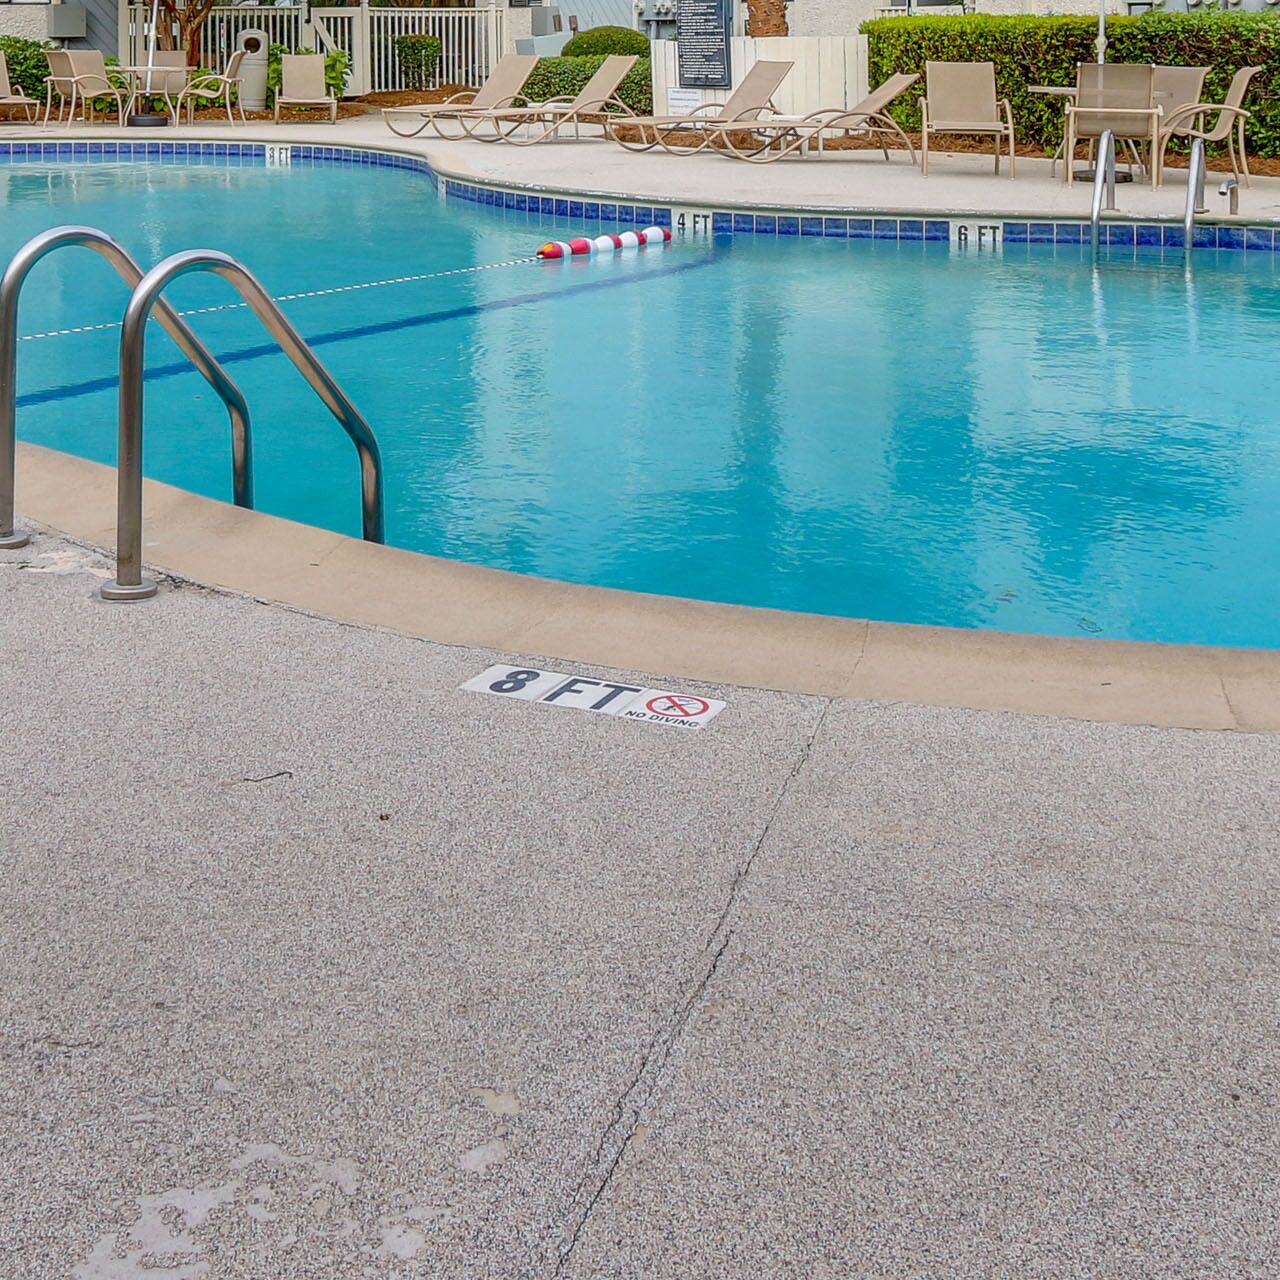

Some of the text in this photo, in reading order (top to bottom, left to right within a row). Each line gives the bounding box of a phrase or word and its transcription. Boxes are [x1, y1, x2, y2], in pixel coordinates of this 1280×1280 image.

[279, 147, 289, 160] FT
[678, 213, 710, 230] 4 FT
[958, 225, 999, 241] 6 FT
[489, 670, 641, 710] 8 FT
[624, 710, 700, 728] NO DIVING
